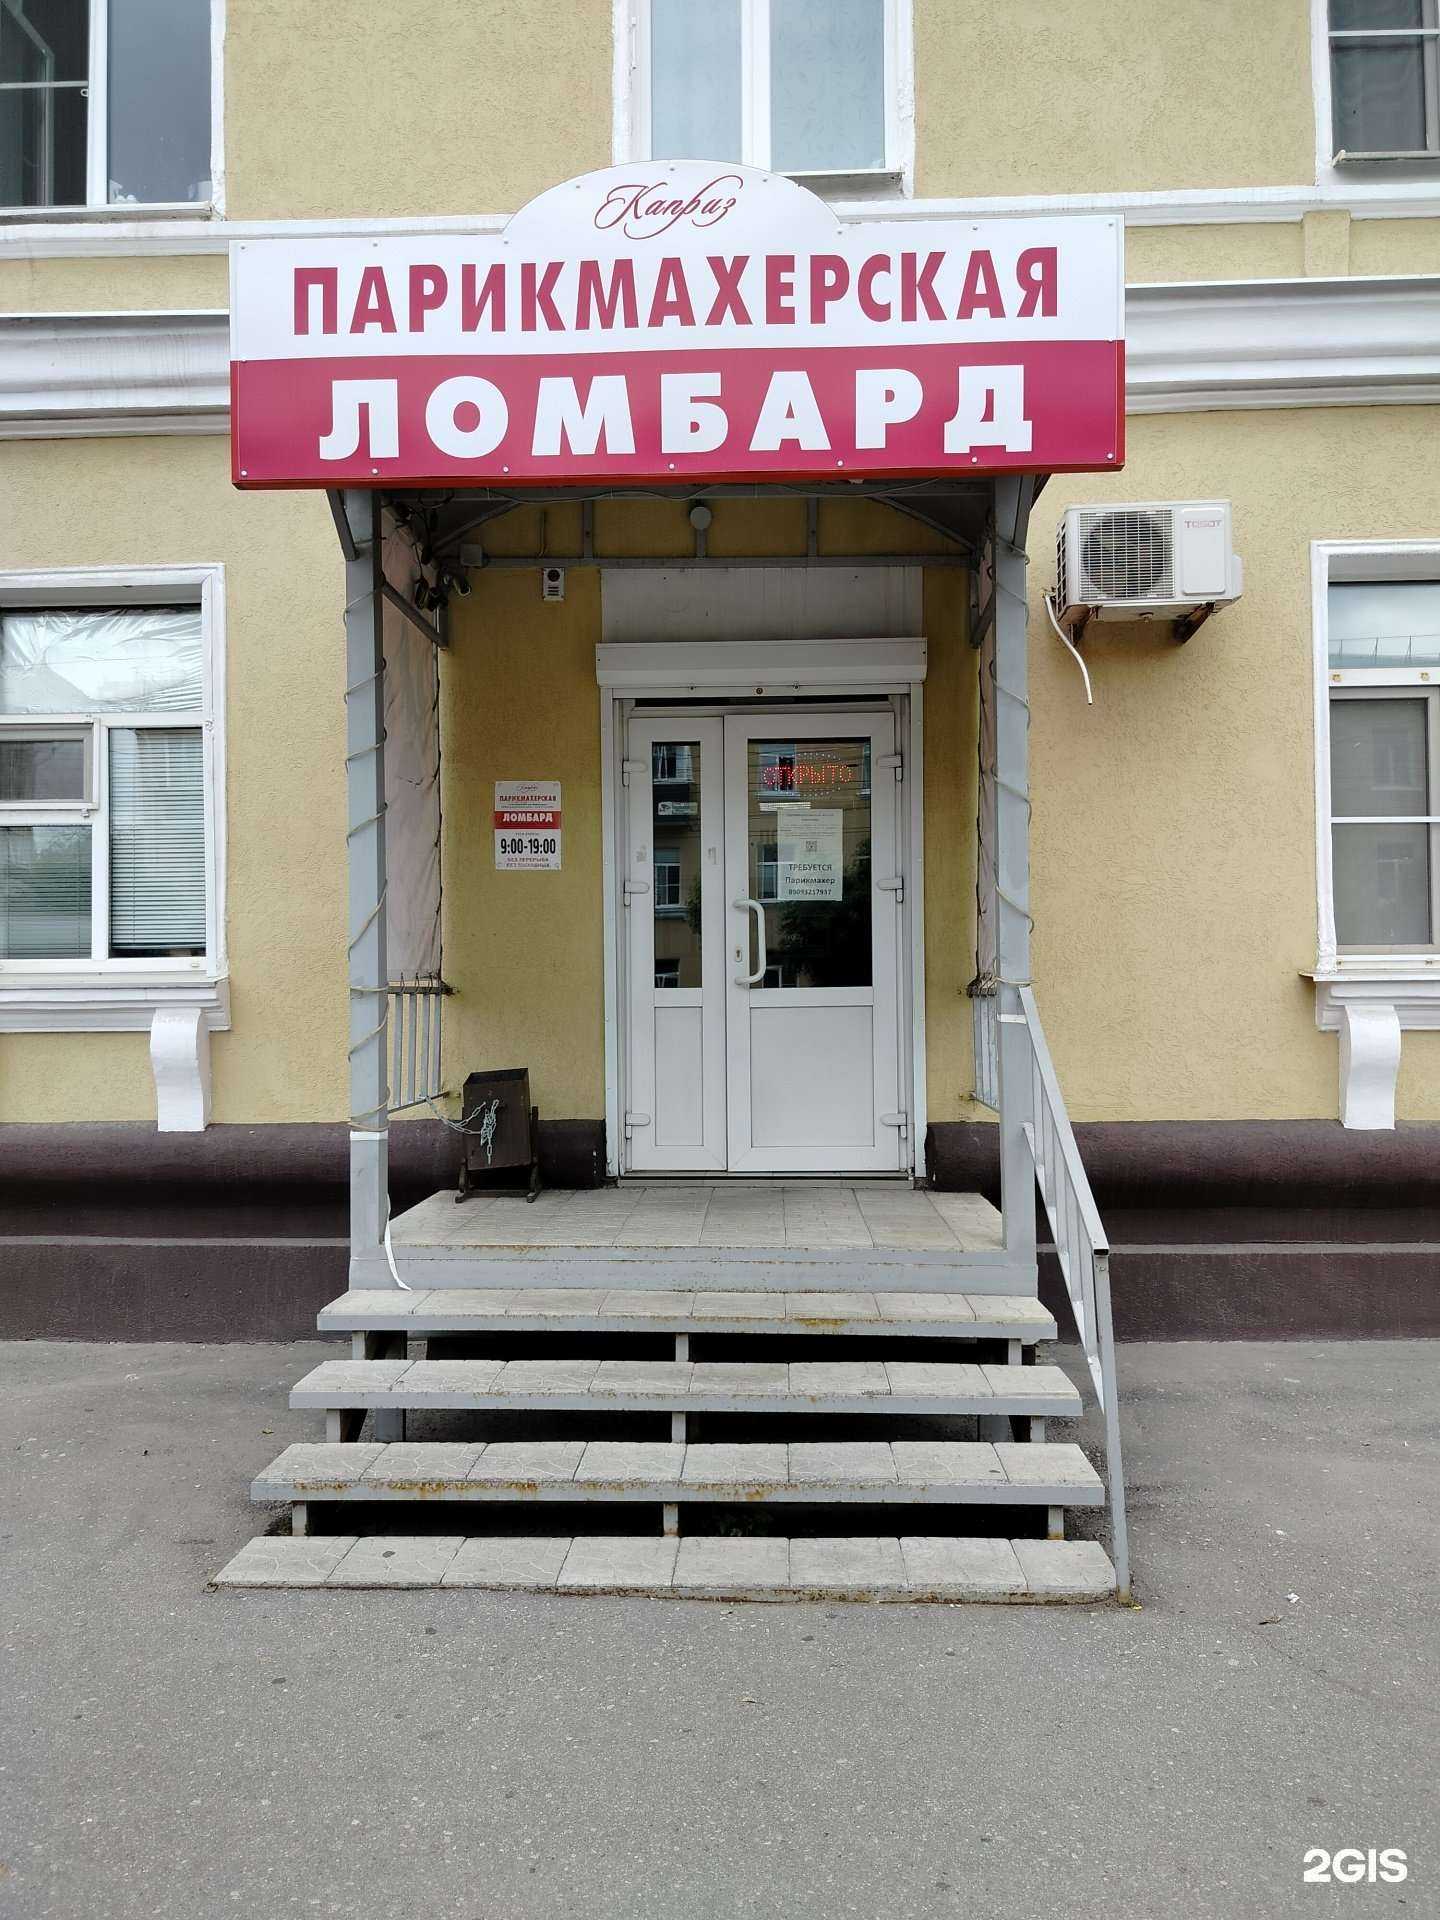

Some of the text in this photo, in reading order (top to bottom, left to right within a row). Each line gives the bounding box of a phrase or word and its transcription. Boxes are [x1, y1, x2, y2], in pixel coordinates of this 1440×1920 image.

[594, 175, 744, 241] Каприз
[293, 246, 1059, 336] ПАРИКМАХЕРСКАЯ
[319, 364, 1034, 461] ЛОМБАРД
[763, 765, 852, 785] ОТКРЫТО
[503, 813, 553, 822] ЛОМБАРД
[501, 838, 556, 854] 9:00-19:00
[788, 863, 832, 871] ТРЕБУЕТСЯ
[785, 876, 836, 885] Парикмахер
